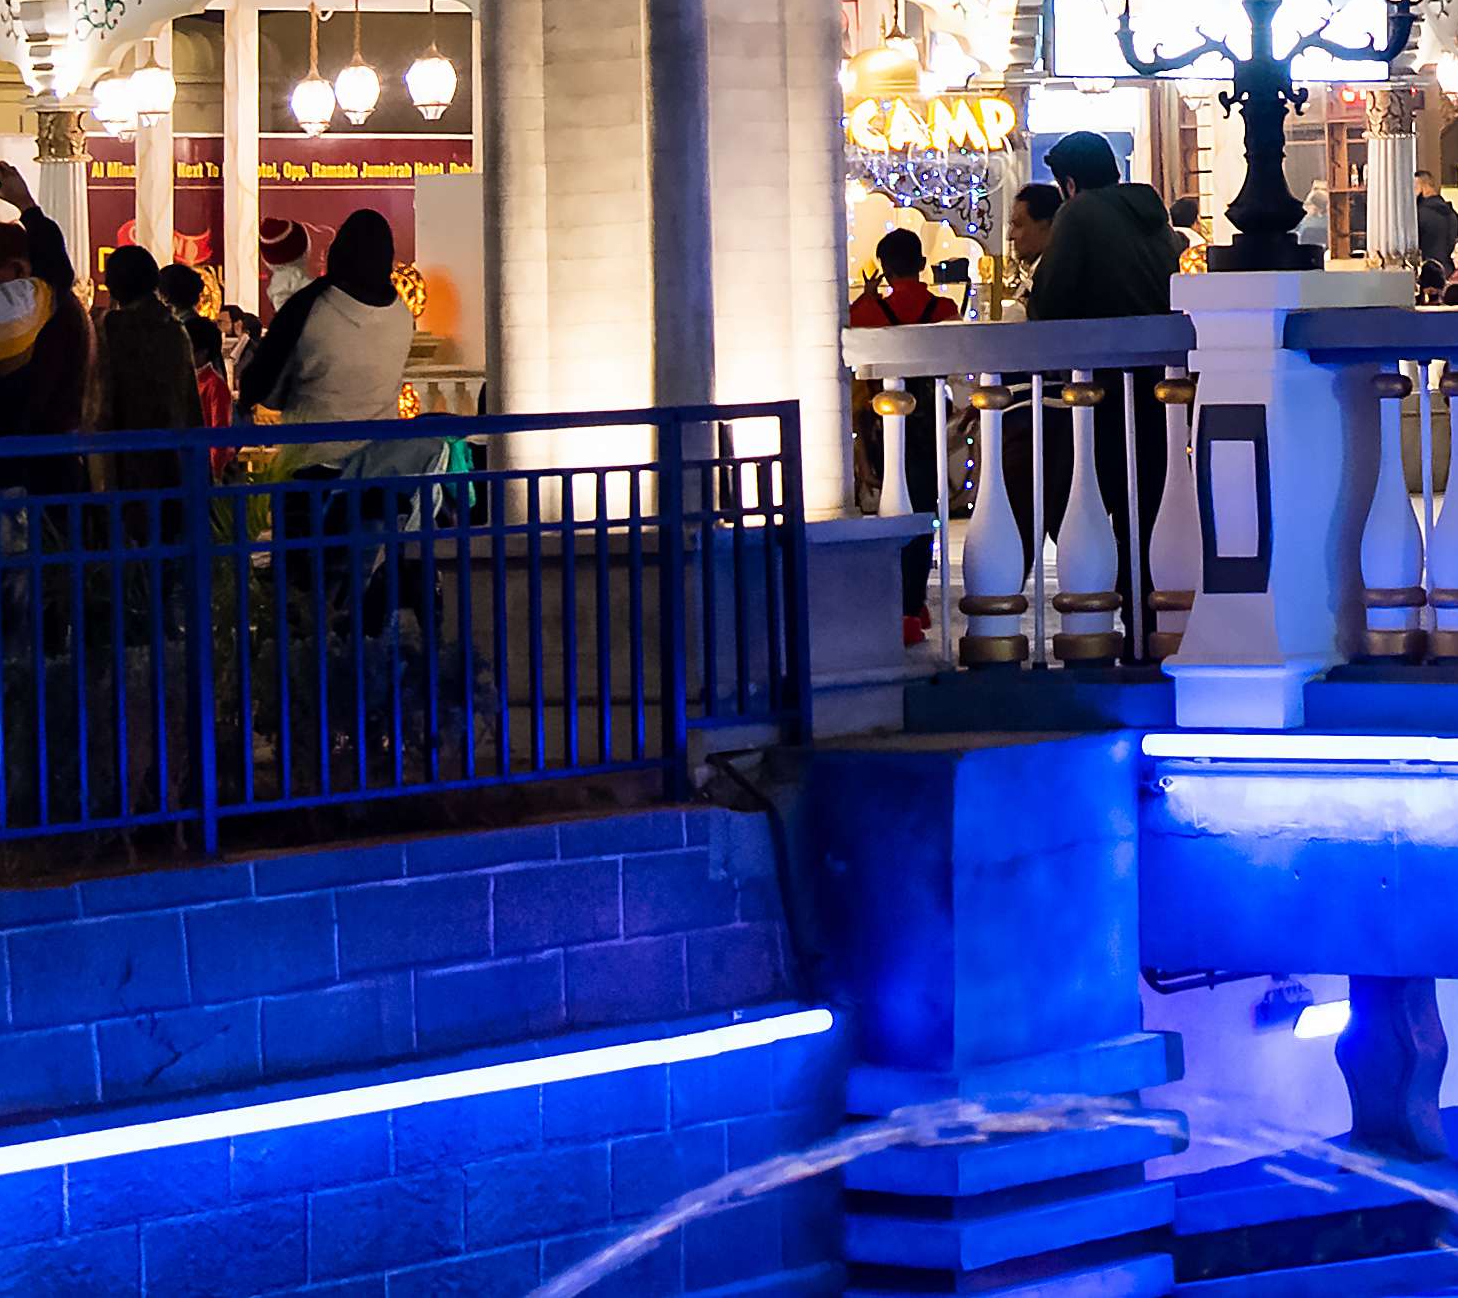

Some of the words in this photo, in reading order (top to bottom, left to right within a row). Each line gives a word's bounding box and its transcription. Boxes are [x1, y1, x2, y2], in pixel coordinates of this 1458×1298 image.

[851, 97, 1016, 151] CAMP
[91, 161, 104, 178] Al
[177, 162, 203, 178] Next
[205, 162, 220, 178] To
[312, 162, 358, 179] Ramada
[360, 162, 412, 179] Jumeirah
